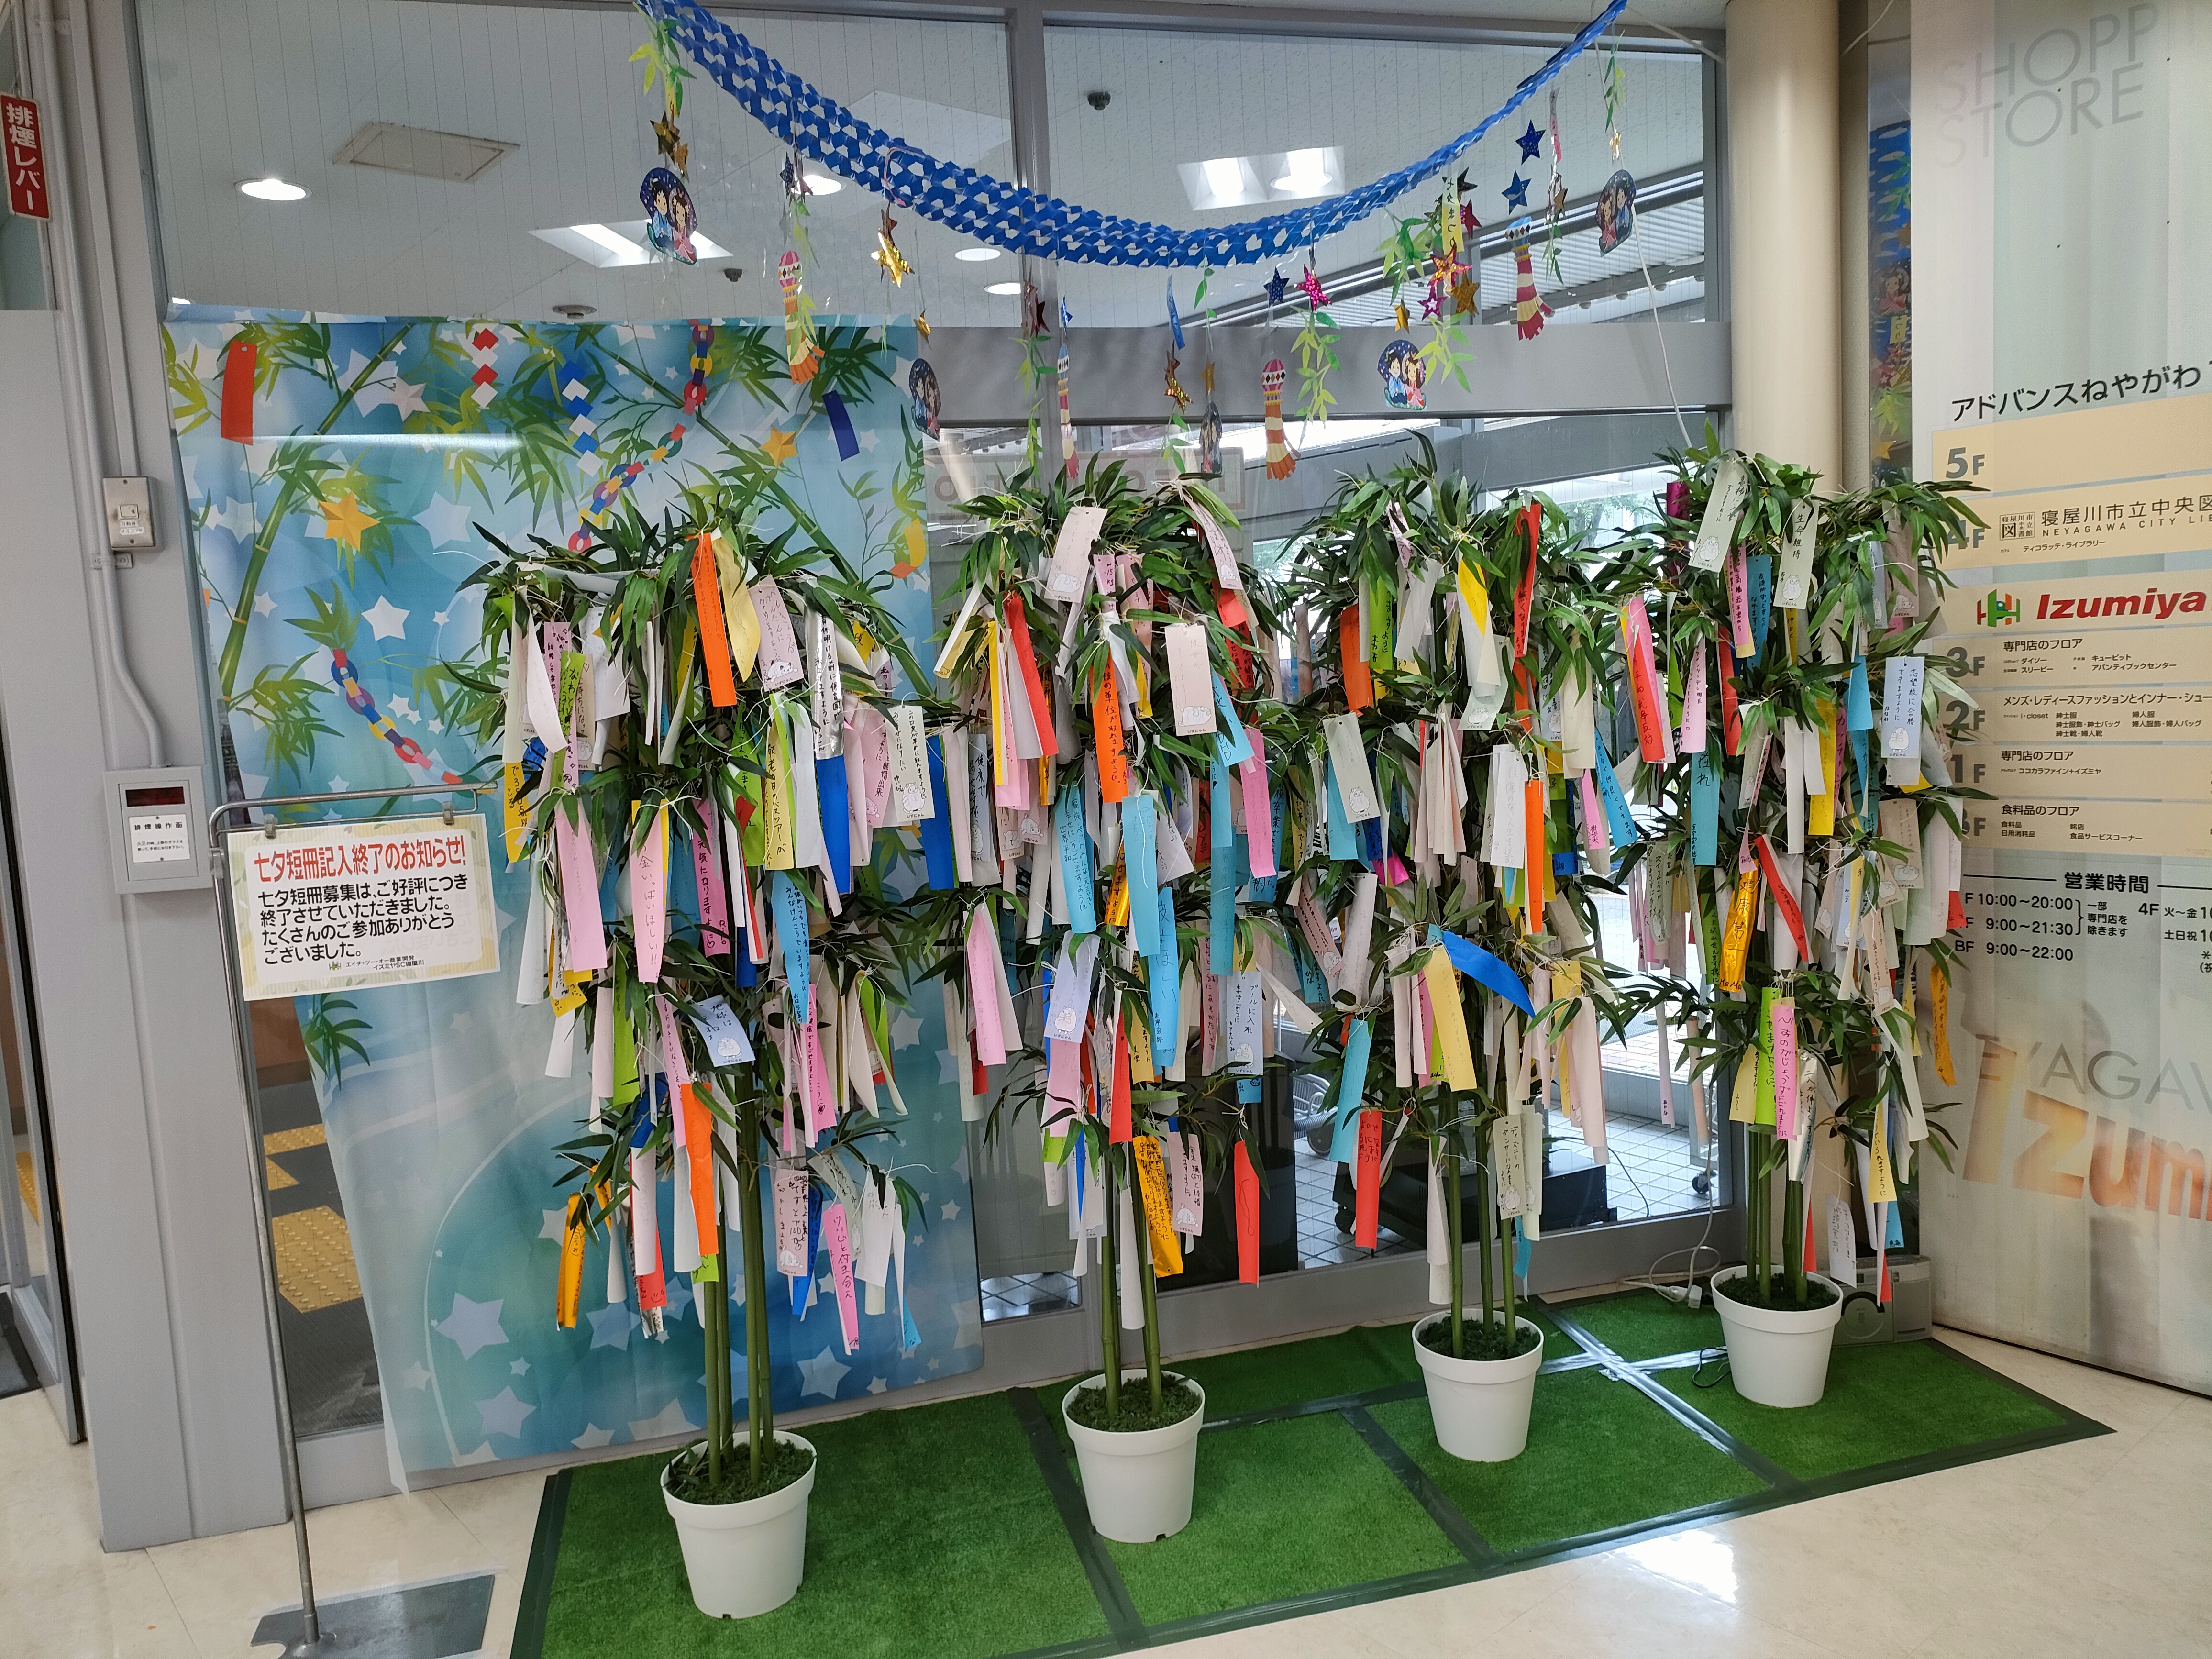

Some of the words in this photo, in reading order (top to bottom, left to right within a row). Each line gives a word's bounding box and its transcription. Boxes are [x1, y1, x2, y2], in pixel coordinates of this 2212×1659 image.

[6, 102, 41, 210] 排煙レバー
[1945, 447, 1985, 478] 5F
[2043, 522, 2126, 537] NEYAGAWA
[2138, 518, 2177, 528] CITY
[2023, 540, 2107, 553] ティコラッテ・ライブラリー
[2036, 587, 2207, 620] Izumiya
[2003, 638, 2083, 652] 専門店のフロア
[1945, 647, 1986, 678] 3F
[2092, 662, 2177, 671] アバンティブックセンター
[1906, 668, 1919, 726] 志望校に合格
[1945, 700, 1986, 730] 2F
[2132, 719, 2202, 728] 婦人服飾・婦人バッグ
[2001, 750, 2074, 761] 専門店のフロア
[2001, 805, 2079, 816] 食料品のフロア
[2001, 830, 2036, 838] 日用消耗品
[2069, 832, 2143, 841] 食品サービスコーナー
[254, 835, 466, 883] 七夕短冊記入終了のお知らせ!
[2064, 872, 2149, 894] 営業時間
[258, 874, 468, 908] 七夕短冊募集は、ご好評につき
[260, 895, 450, 928] 終了させていただきました。
[2087, 901, 2108, 911] 一部
[2138, 902, 2160, 916] 4F
[2087, 913, 2128, 925] 専門店を
[262, 914, 454, 946] たくさんのご参加ありがとう
[2087, 925, 2128, 937] 除きます
[2164, 929, 2198, 941] 土日祝
[264, 941, 361, 964] ございました。
[1955, 940, 1975, 952] BF
